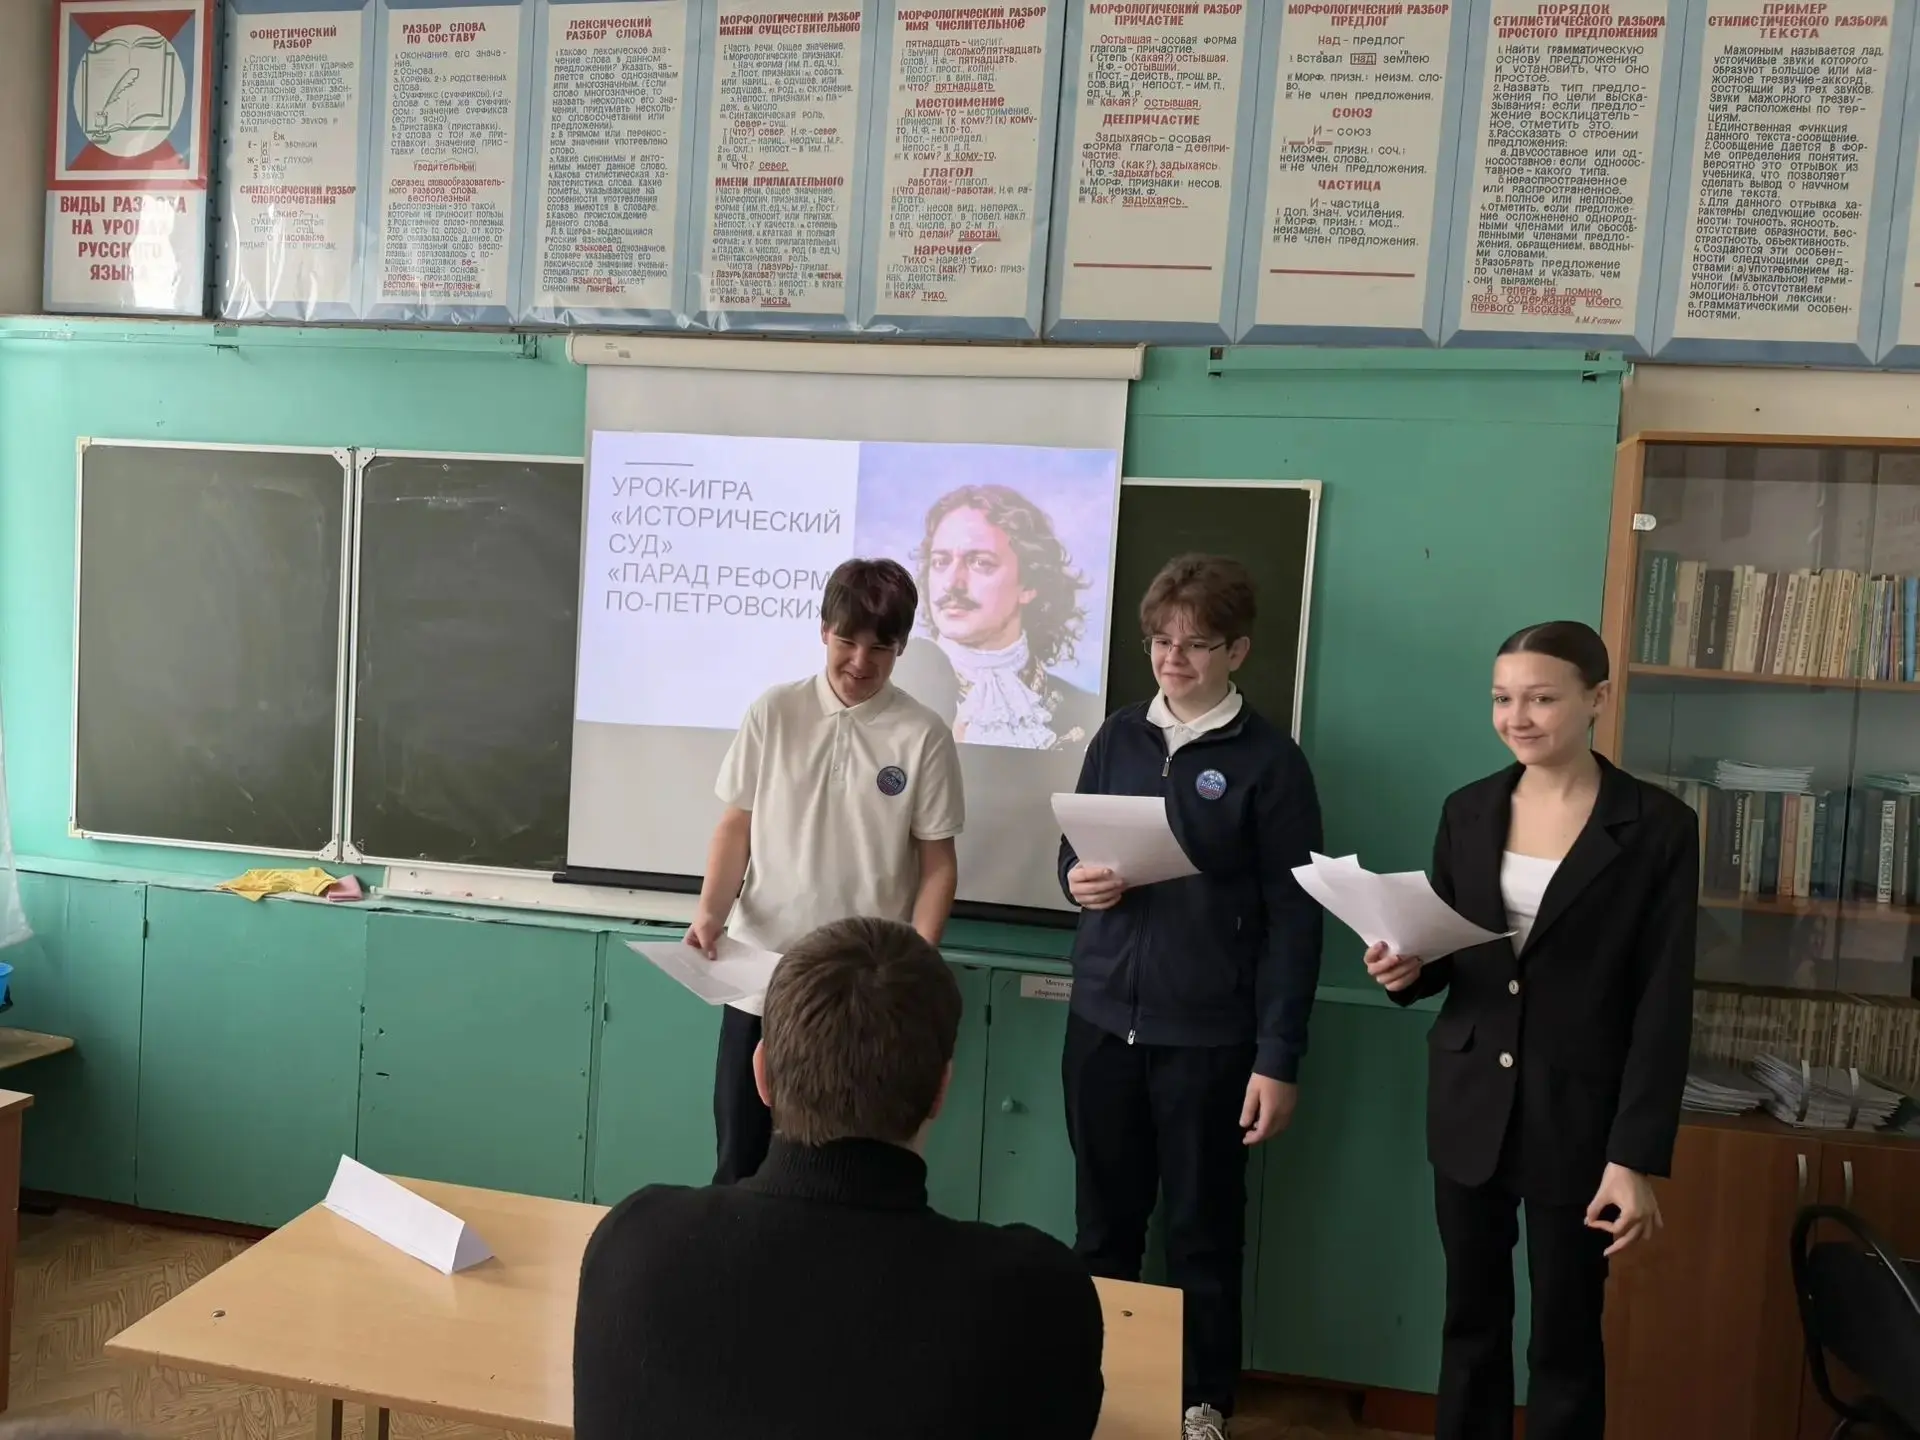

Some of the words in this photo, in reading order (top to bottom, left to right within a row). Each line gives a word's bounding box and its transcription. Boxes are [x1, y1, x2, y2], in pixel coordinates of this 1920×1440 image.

[1009, 7, 1046, 17] РАЗБОР
[1090, 2, 1198, 14] МОРФОЛОГИЧЕСКИЙ
[1204, 4, 1242, 14] РАЗБОР
[1288, 2, 1402, 14] МОРФОЛОГИЧЕСКИЙ
[1407, 4, 1449, 14] РАЗБОР
[1538, 4, 1610, 19] ПОРЯДОК
[1763, 4, 1827, 14] ПРИМЕР
[828, 11, 860, 22] РАЗБОР
[1115, 15, 1183, 25] ПРИЧАСТИЕ
[1494, 16, 1612, 26] СТИЛИСТИЧЕСКОГО
[1618, 16, 1665, 26] РАЗБОРА
[1709, 16, 1829, 26] СТИЛИСТИЧЕСКОГО
[1835, 16, 1888, 26] РАЗБОРА
[906, 21, 929, 31] ИМЯ
[1331, 16, 1389, 29] ПРЕДЛОГ
[403, 24, 441, 34] РАЗБОР
[450, 22, 486, 32] СЛОВА
[720, 26, 753, 36] ИМЕНИ
[1760, 28, 1820, 38] ТЕКСТА
[407, 35, 420, 44] ПО
[428, 32, 476, 43] СОСТАВУ
[566, 30, 607, 40] РАЗБОР
[616, 29, 652, 38] СЛОВА
[1499, 28, 1558, 38] ПРОСТОГО
[1565, 28, 1658, 40] ПРЕДЛОЖЕНИЯ
[273, 39, 312, 49] РАЗБОР
[1318, 36, 1341, 45] Над
[1353, 36, 1405, 45] предлог
[1547, 46, 1644, 55] грамматическую
[1723, 45, 1783, 55] Мажорным
[1791, 47, 1855, 56] называется
[1496, 55, 1540, 64] основу
[1550, 55, 1637, 65] предложения
[1784, 57, 1814, 65] звуки
[1625, 65, 1649, 74] оно
[1713, 66, 1764, 74] образуют
[1772, 66, 1820, 74] большое
[1828, 66, 1848, 75] или
[1494, 74, 1550, 83] простое.
[1320, 92, 1348, 100] член
[1355, 92, 1434, 101] предложения.
[1332, 108, 1373, 118] СОЮЗ
[1103, 114, 1200, 127] ДЕЕПРИЧАСТИЕ
[1337, 128, 1372, 136] союз
[1706, 132, 1749, 142] данного
[1096, 132, 1157, 143] Задыхаясь
[1169, 134, 1211, 142] особая
[1083, 143, 1122, 151] форма
[1312, 164, 1338, 172] член
[1346, 164, 1427, 174] предложения.
[716, 177, 748, 186] ИМЕНИ
[754, 176, 844, 186] ПРИЛАГАТЕЛЬНОГО
[1318, 180, 1381, 192] ЧАСТИЦА
[326, 186, 356, 194] РАЗБОР
[1483, 185, 1504, 193] или
[1700, 189, 1733, 197] стиле
[60, 196, 105, 216] ВИДЫ
[113, 196, 186, 213] РАЗА
[1331, 200, 1380, 210] частица
[72, 219, 92, 234] НА
[1542, 260, 1620, 270] предложение
[1493, 268, 1533, 276] членам
[1473, 276, 1493, 285] они
[1500, 277, 1558, 286] выражены.
[611, 476, 753, 500] УРОК-ИГРА
[611, 505, 840, 534] «ИСТОРИЧЕСКИЙ
[609, 534, 673, 558] СУД»
[608, 562, 708, 588] «ПАРАД
[717, 566, 830, 590] РЕФОРМ
